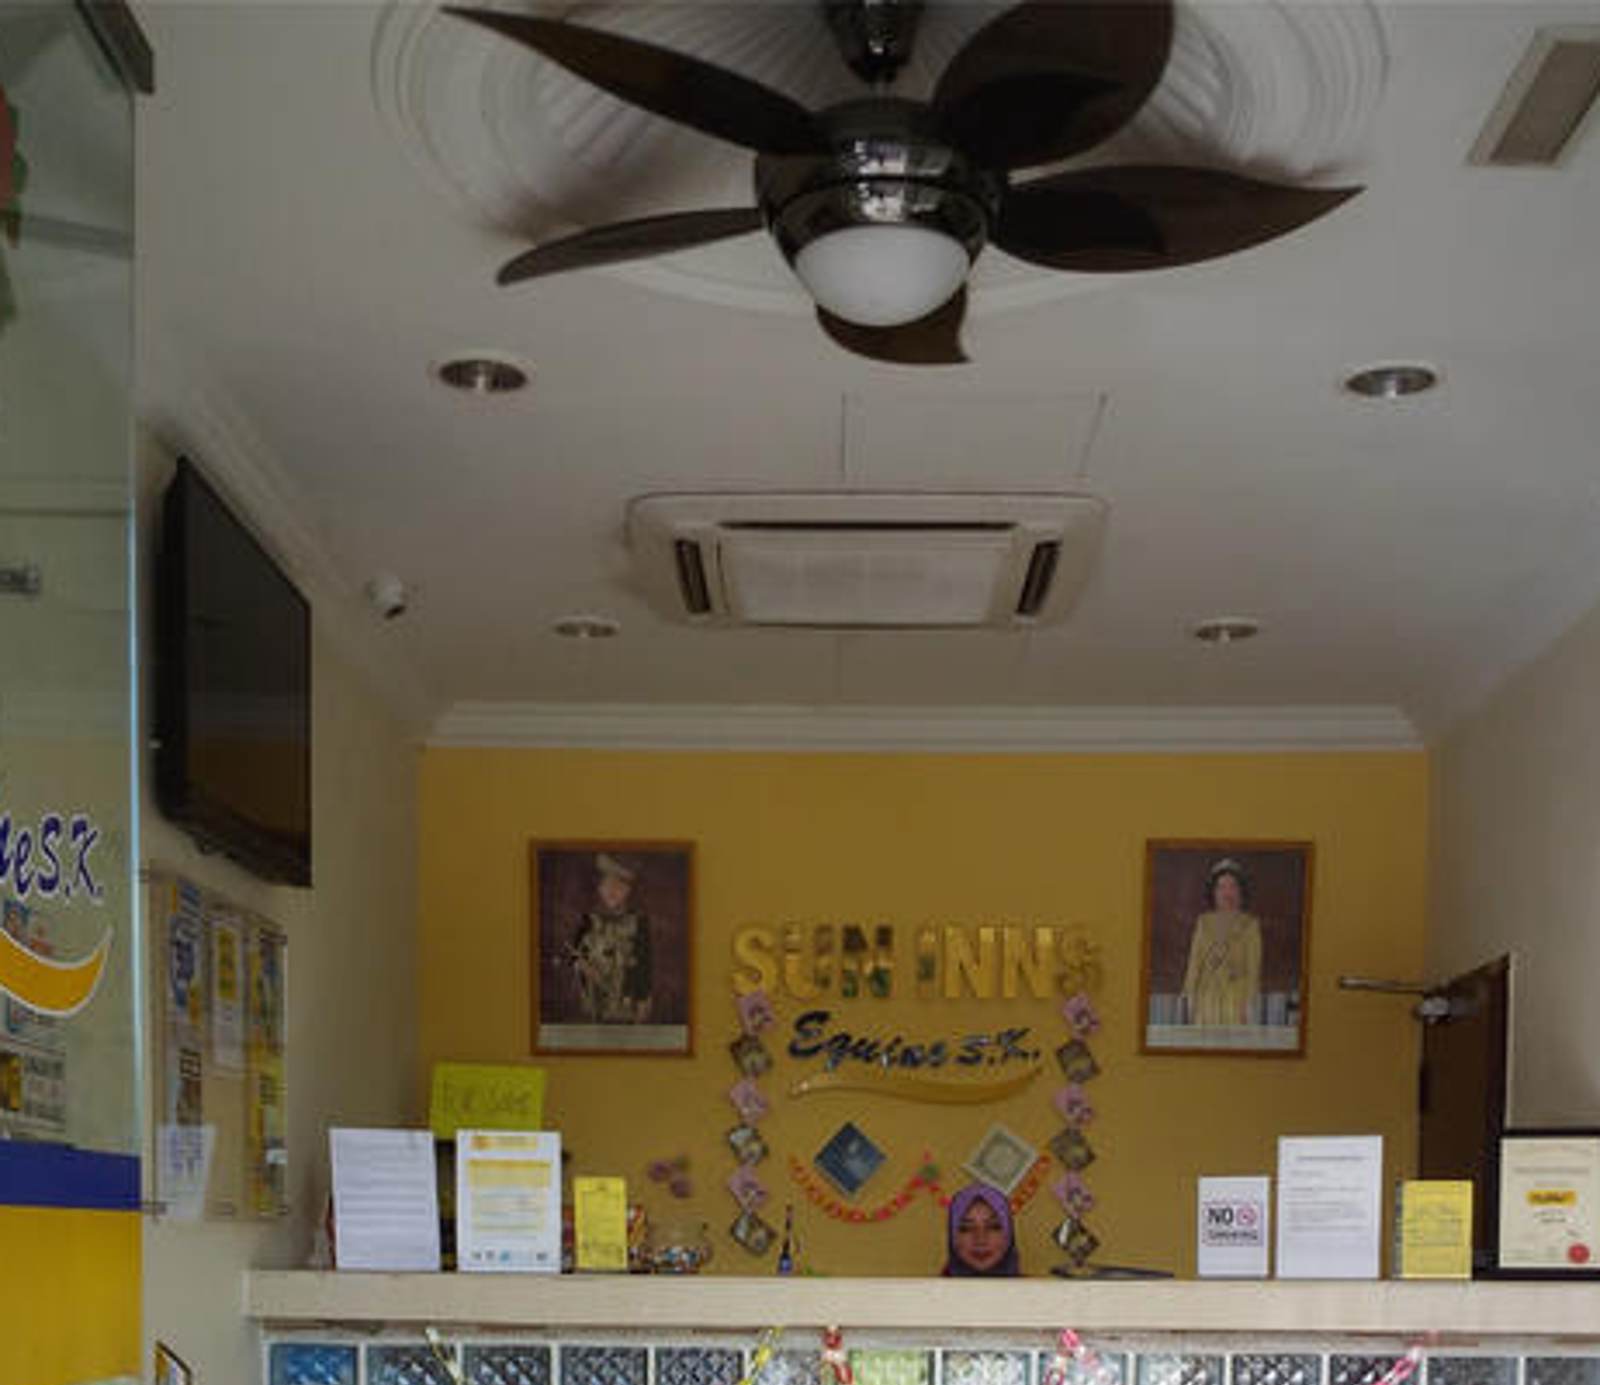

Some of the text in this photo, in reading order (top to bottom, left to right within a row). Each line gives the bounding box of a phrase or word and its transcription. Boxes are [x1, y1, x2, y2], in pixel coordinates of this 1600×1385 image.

[732, 923, 1099, 999] SUN INNS
[788, 1010, 947, 1071] Equine
[1207, 1207, 1234, 1226] NO
